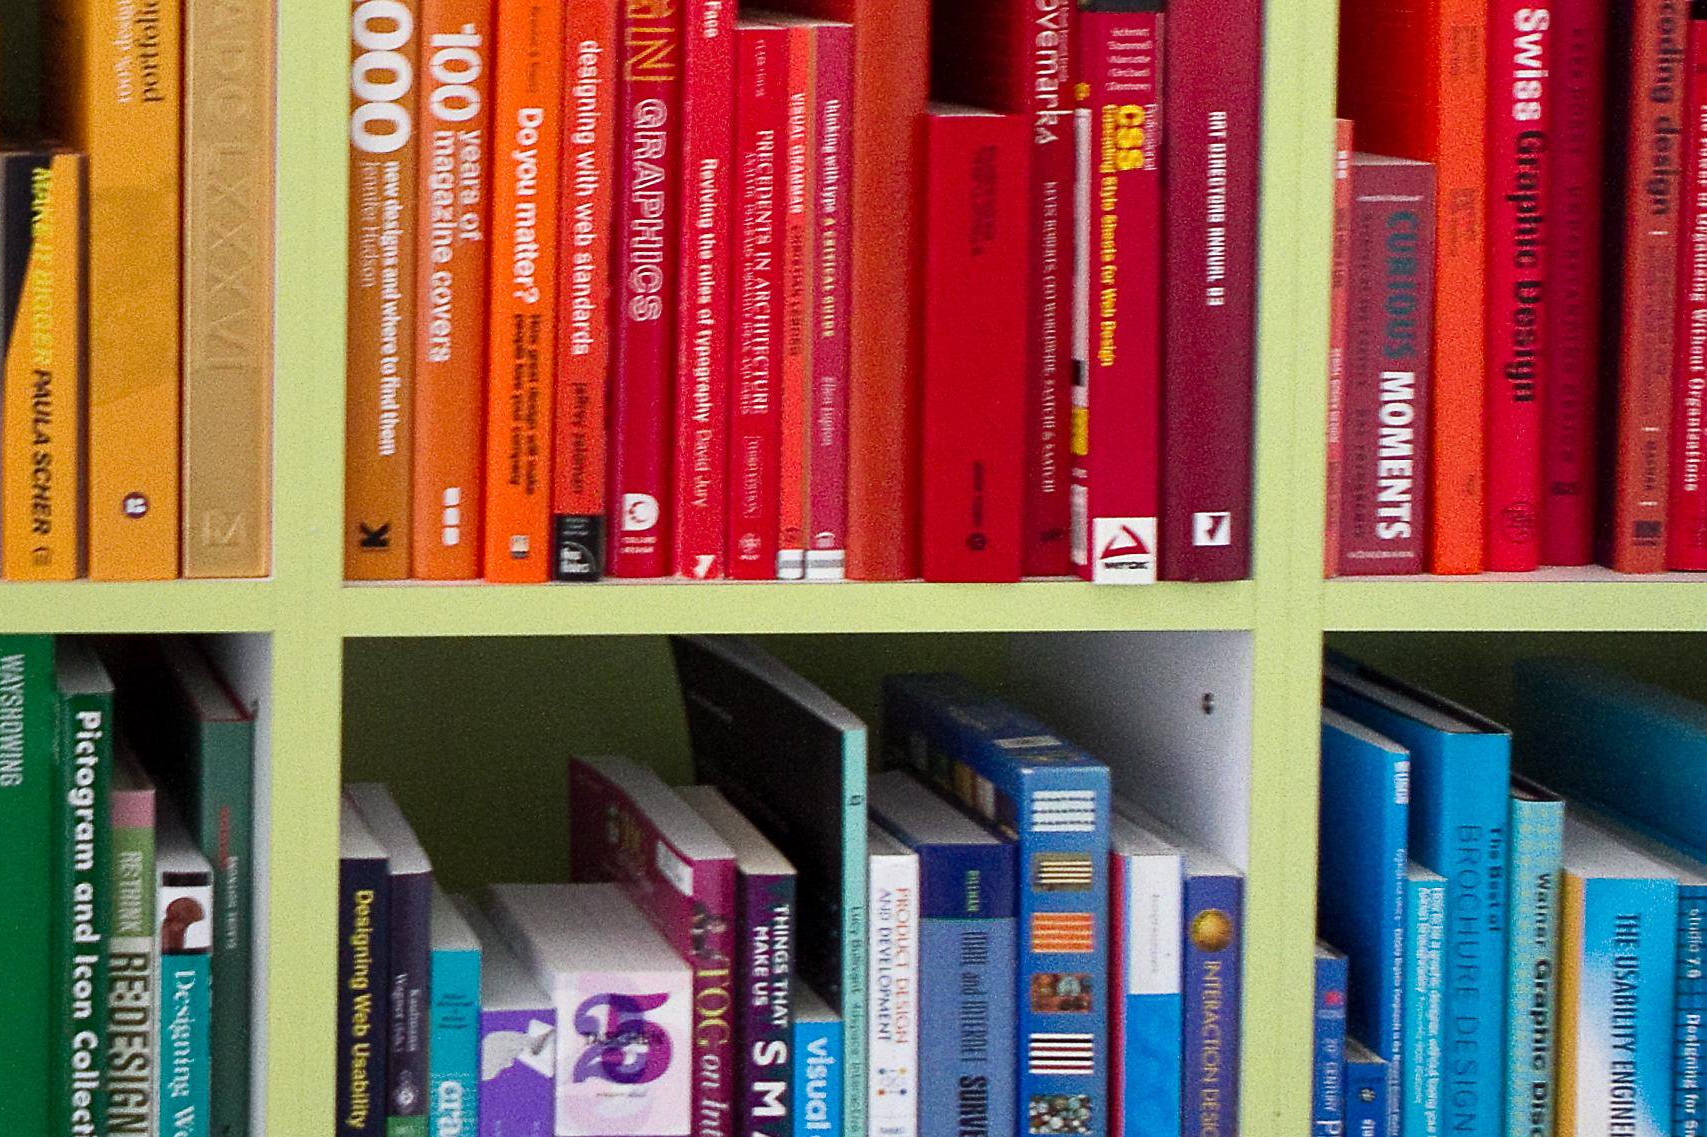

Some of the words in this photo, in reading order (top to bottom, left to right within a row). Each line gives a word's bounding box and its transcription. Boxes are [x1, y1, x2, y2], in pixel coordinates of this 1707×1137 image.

[429, 24, 482, 121] 100
[568, 40, 599, 144] designing
[1512, 7, 1549, 122] Swiss
[513, 108, 545, 145] Do
[789, 93, 806, 143] VISUAL
[821, 99, 840, 153] thinking
[1116, 103, 1145, 171] CSS
[1206, 111, 1227, 138] ART
[382, 161, 402, 196] new
[427, 130, 456, 263] magazine
[456, 129, 481, 208] years
[513, 149, 545, 196] you
[568, 151, 599, 195] with
[693, 158, 718, 227] Reviving
[789, 145, 806, 213] GRAMMAR
[1206, 143, 1227, 223] DIRECTORS
[1506, 130, 1548, 271] Graphic
[1646, 116, 1676, 216] design
[463, 214, 483, 241] of
[568, 202, 599, 246] web
[629, 99, 666, 322] GRAPHICS
[693, 233, 718, 260] the
[378, 268, 404, 299] and
[513, 202, 545, 303] matter?
[693, 264, 718, 304] rules
[1206, 227, 1227, 282] ANNUAL
[1385, 211, 1419, 360] CURIOUS
[378, 302, 404, 355] where
[426, 271, 453, 363] covers
[568, 252, 599, 356] standards
[693, 308, 718, 326] of
[1503, 279, 1539, 403] Design
[1689, 309, 1706, 373] Without
[30, 369, 52, 444] PAULA
[693, 330, 718, 423] typography
[378, 412, 404, 455] them
[1375, 370, 1415, 541] MOMENTS
[1685, 378, 1704, 492] Organizations
[30, 451, 52, 535] SCHER
[66, 710, 102, 871] Pictogram
[1487, 826, 1503, 861] The
[72, 882, 99, 943] and
[876, 888, 893, 921] AND
[1453, 824, 1483, 1000] BROCHURE
[1487, 865, 1503, 909] Best
[1487, 914, 1503, 932] of
[1533, 872, 1553, 947] Wainer
[346, 889, 375, 990] Designing
[753, 925, 770, 977] MAKE
[771, 904, 791, 974] THINGS
[894, 887, 911, 969] PRODUCT
[1609, 912, 1642, 948] THE
[72, 955, 98, 1019] Icon
[352, 993, 372, 1037] Web
[695, 961, 731, 1048] TOG
[753, 982, 770, 1006] US
[771, 979, 791, 1028] THAT
[876, 927, 893, 1042] DEVELOPMENT
[894, 978, 911, 1045] DESIGN
[958, 971, 989, 996] and
[1529, 958, 1551, 1072] Graphic
[1609, 955, 1642, 1052] USABILITY
[107, 951, 151, 1136] RE:DESIGN
[168, 969, 197, 1098] Designing
[1199, 960, 1222, 1083] INTERACTION
[1684, 1014, 1701, 1090] Designing
[72, 1030, 98, 1137] Collect
[347, 1042, 371, 1128] Usability
[700, 1054, 721, 1090] on
[751, 1040, 788, 1137] SM
[805, 1037, 835, 1130] visual
[1453, 1016, 1483, 1135] DESIGN
[1684, 1093, 1699, 1114] for
